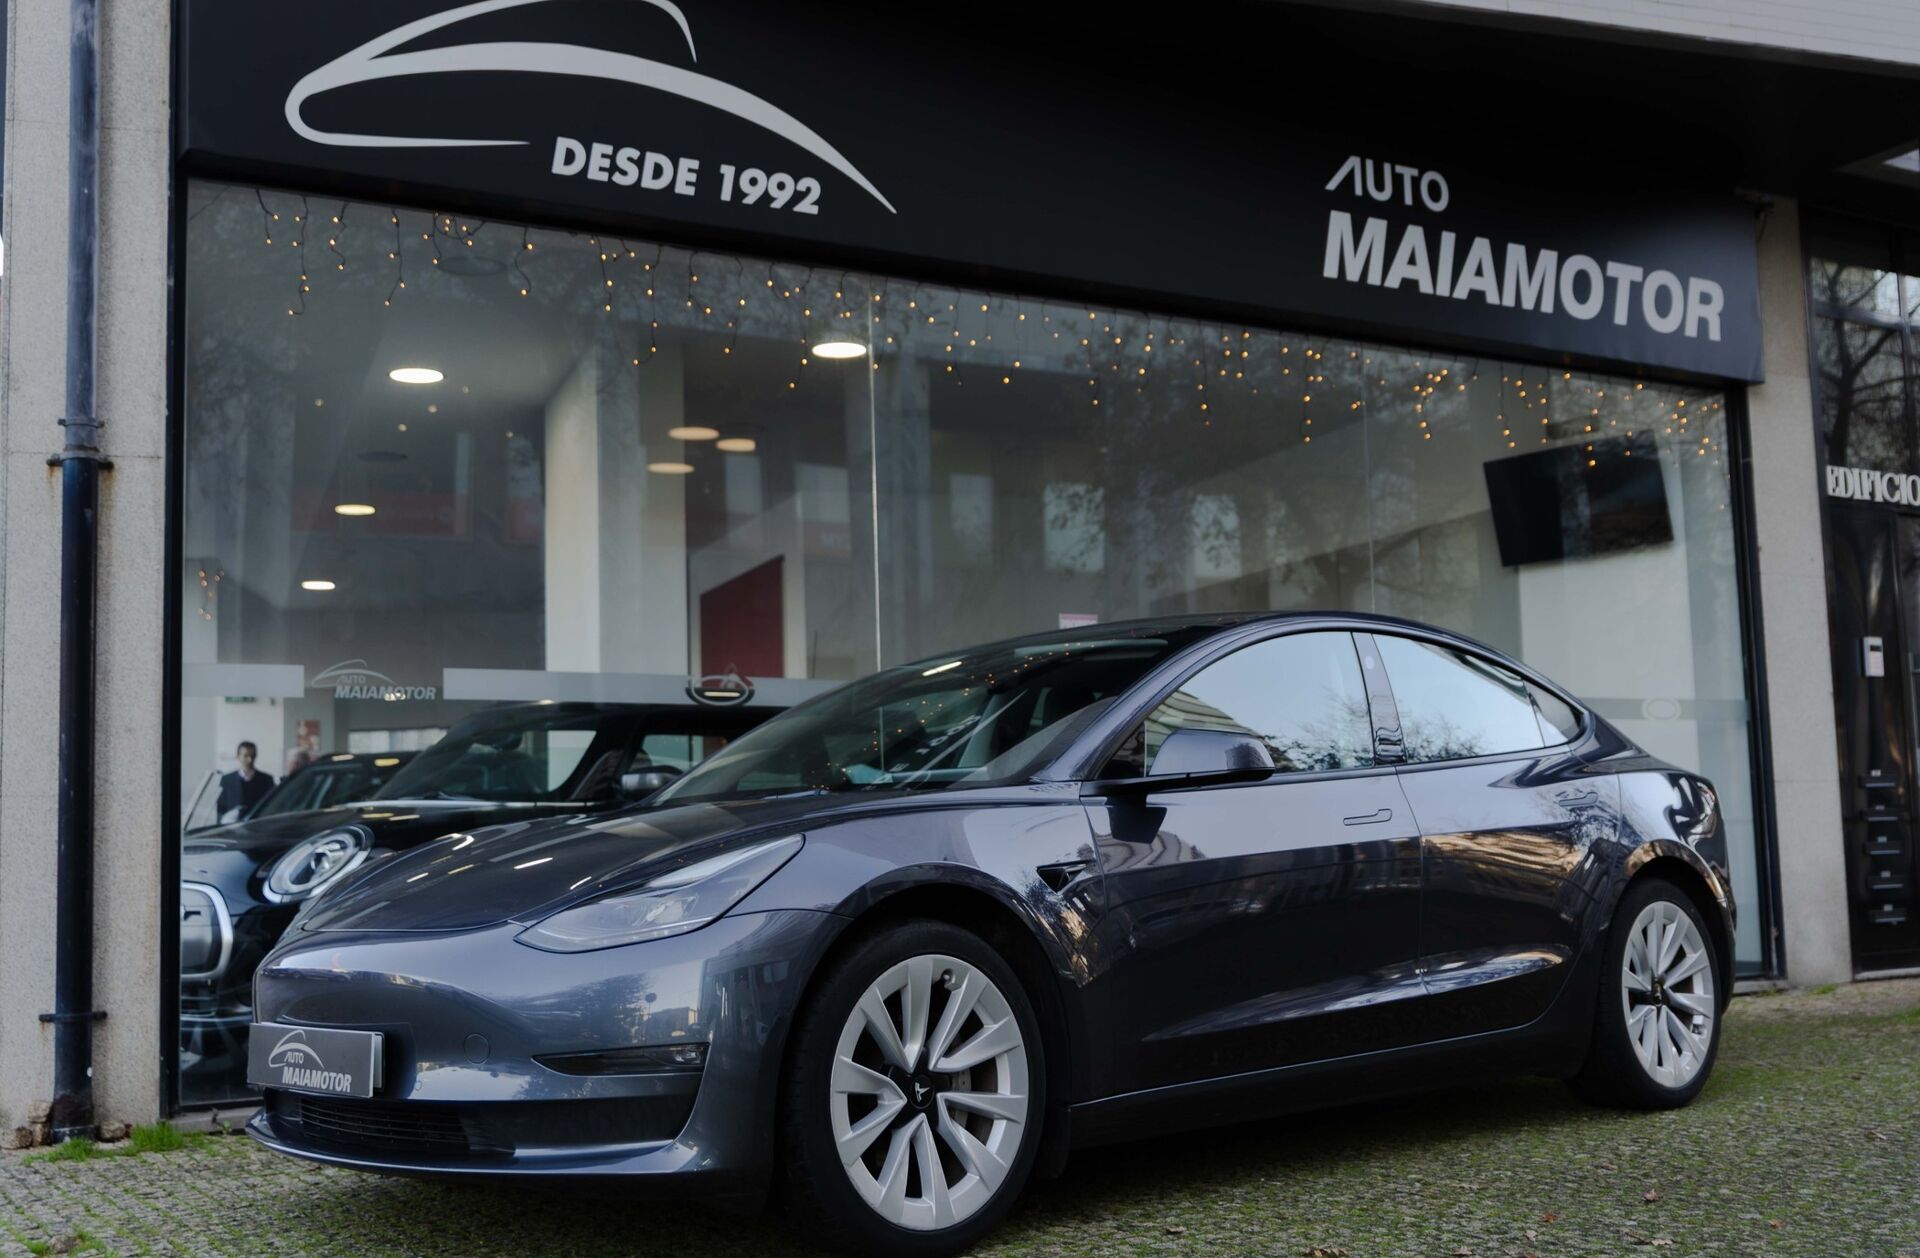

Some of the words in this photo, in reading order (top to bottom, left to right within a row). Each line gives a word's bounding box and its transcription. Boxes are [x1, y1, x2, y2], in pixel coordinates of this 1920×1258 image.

[551, 136, 700, 196] DESDE
[719, 164, 822, 215] 1992
[1325, 155, 1450, 213] AUTO
[1323, 209, 1725, 341] MAIAMOTOR
[1826, 464, 1920, 507] EDIFICIO
[282, 1066, 352, 1093] MAIAMOTOR
[284, 1051, 305, 1064] AUTO
